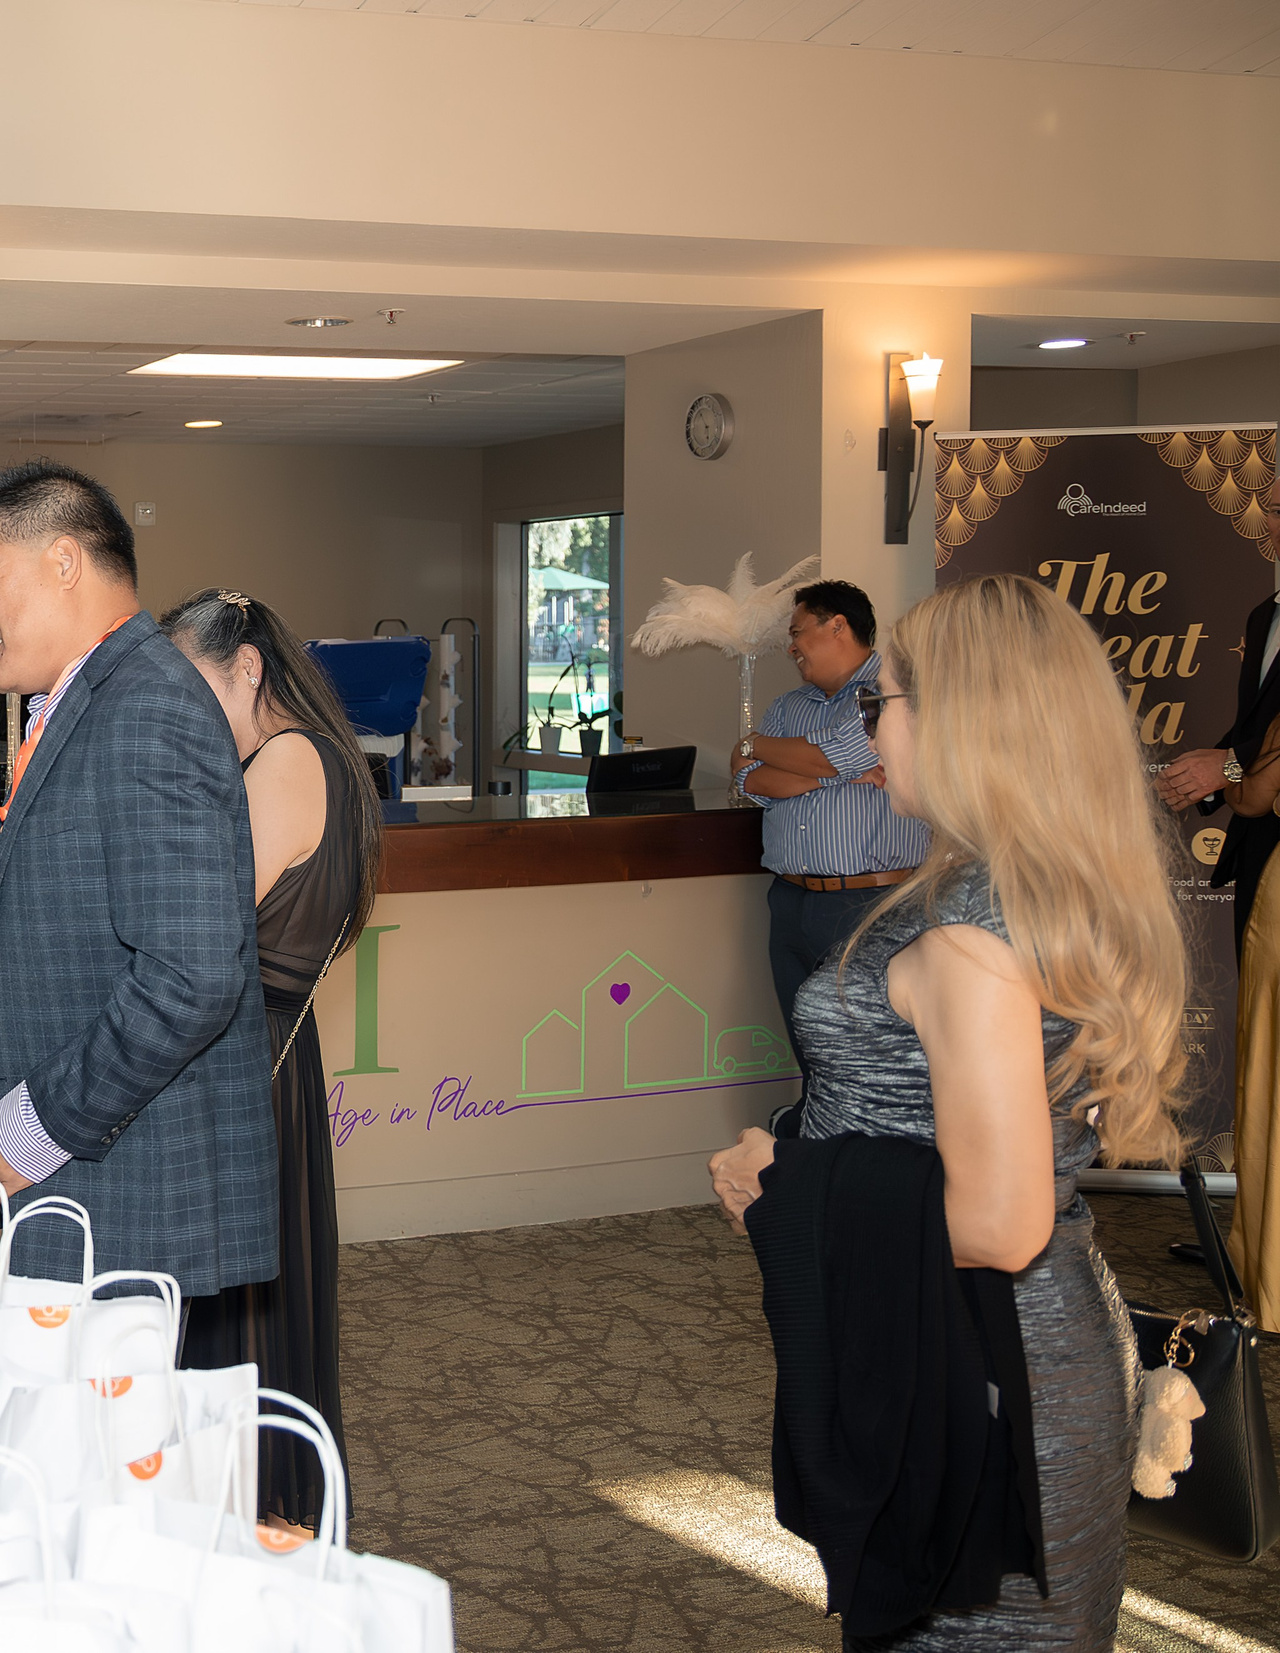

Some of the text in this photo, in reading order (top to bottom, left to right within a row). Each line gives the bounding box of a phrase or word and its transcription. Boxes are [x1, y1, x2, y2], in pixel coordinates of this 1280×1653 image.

[1070, 501, 1147, 514] CareIndeed
[1038, 552, 1168, 615] The
[1176, 889, 1235, 903] for everyo
[326, 1075, 508, 1148] Age in Place
